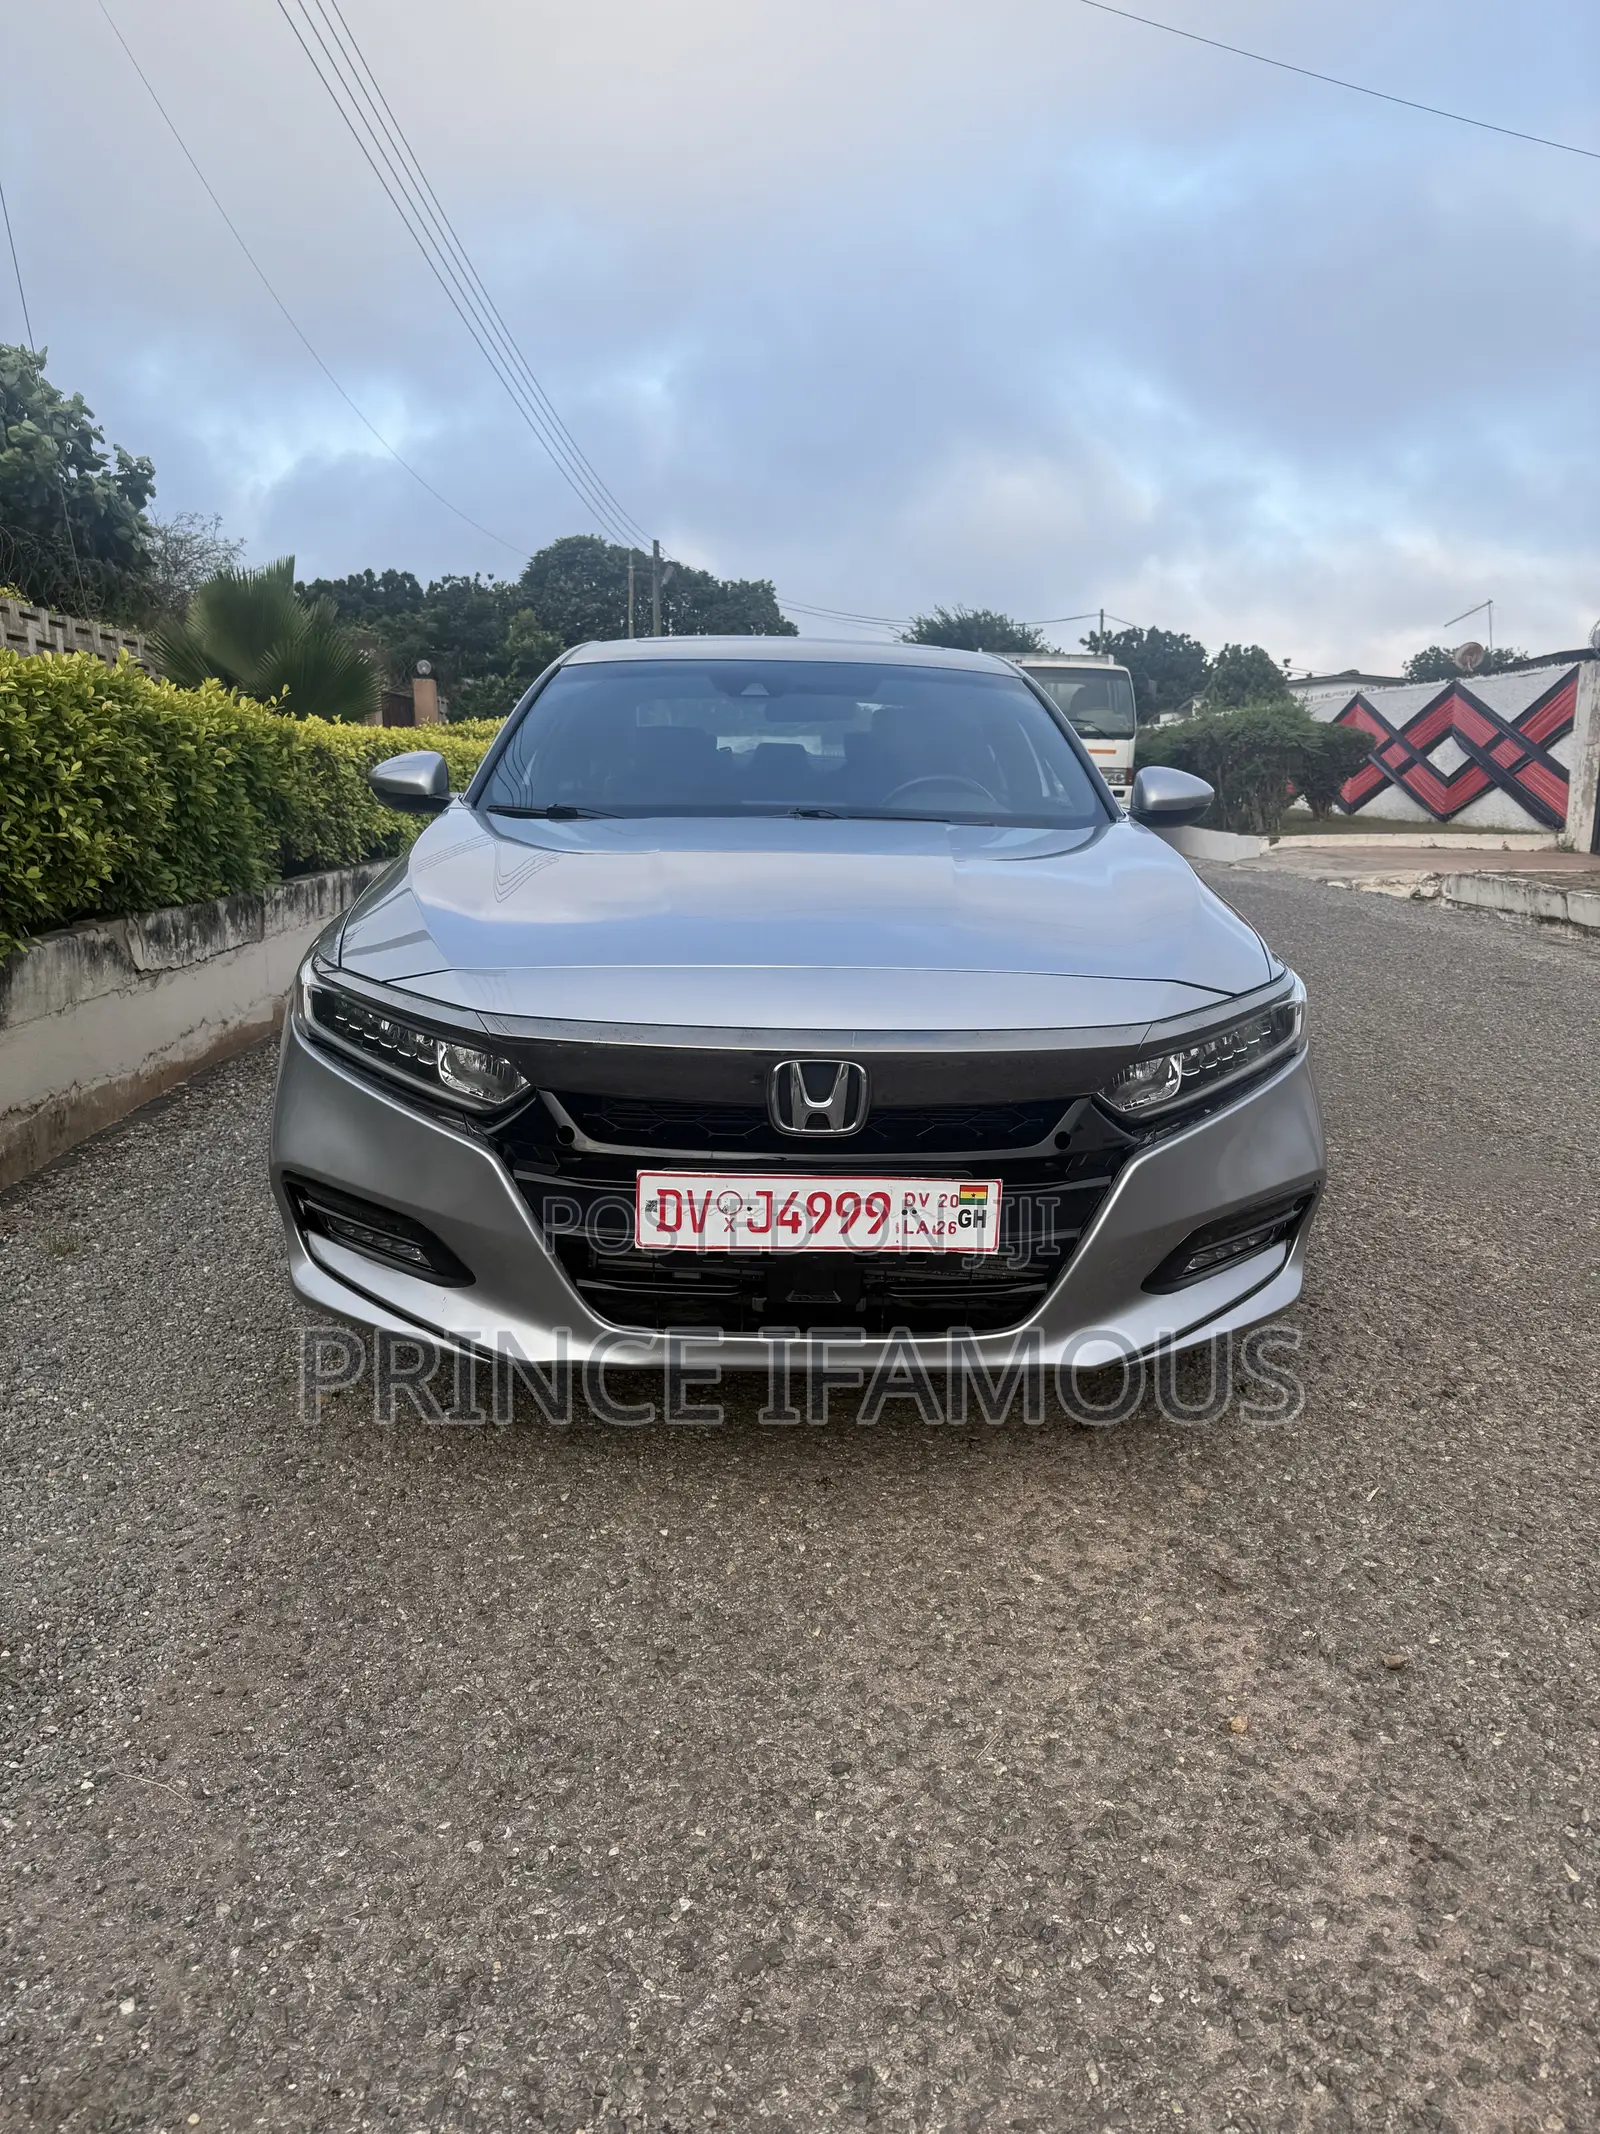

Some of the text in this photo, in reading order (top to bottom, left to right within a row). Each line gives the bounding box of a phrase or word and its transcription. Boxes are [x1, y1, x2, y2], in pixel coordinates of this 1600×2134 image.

[903, 1192, 959, 1208] DV 20
[656, 1188, 713, 1234] DV
[746, 1190, 891, 1236] J4999
[957, 1209, 987, 1229] GH
[903, 1219, 930, 1235] LA
[936, 1220, 957, 1235] 26
